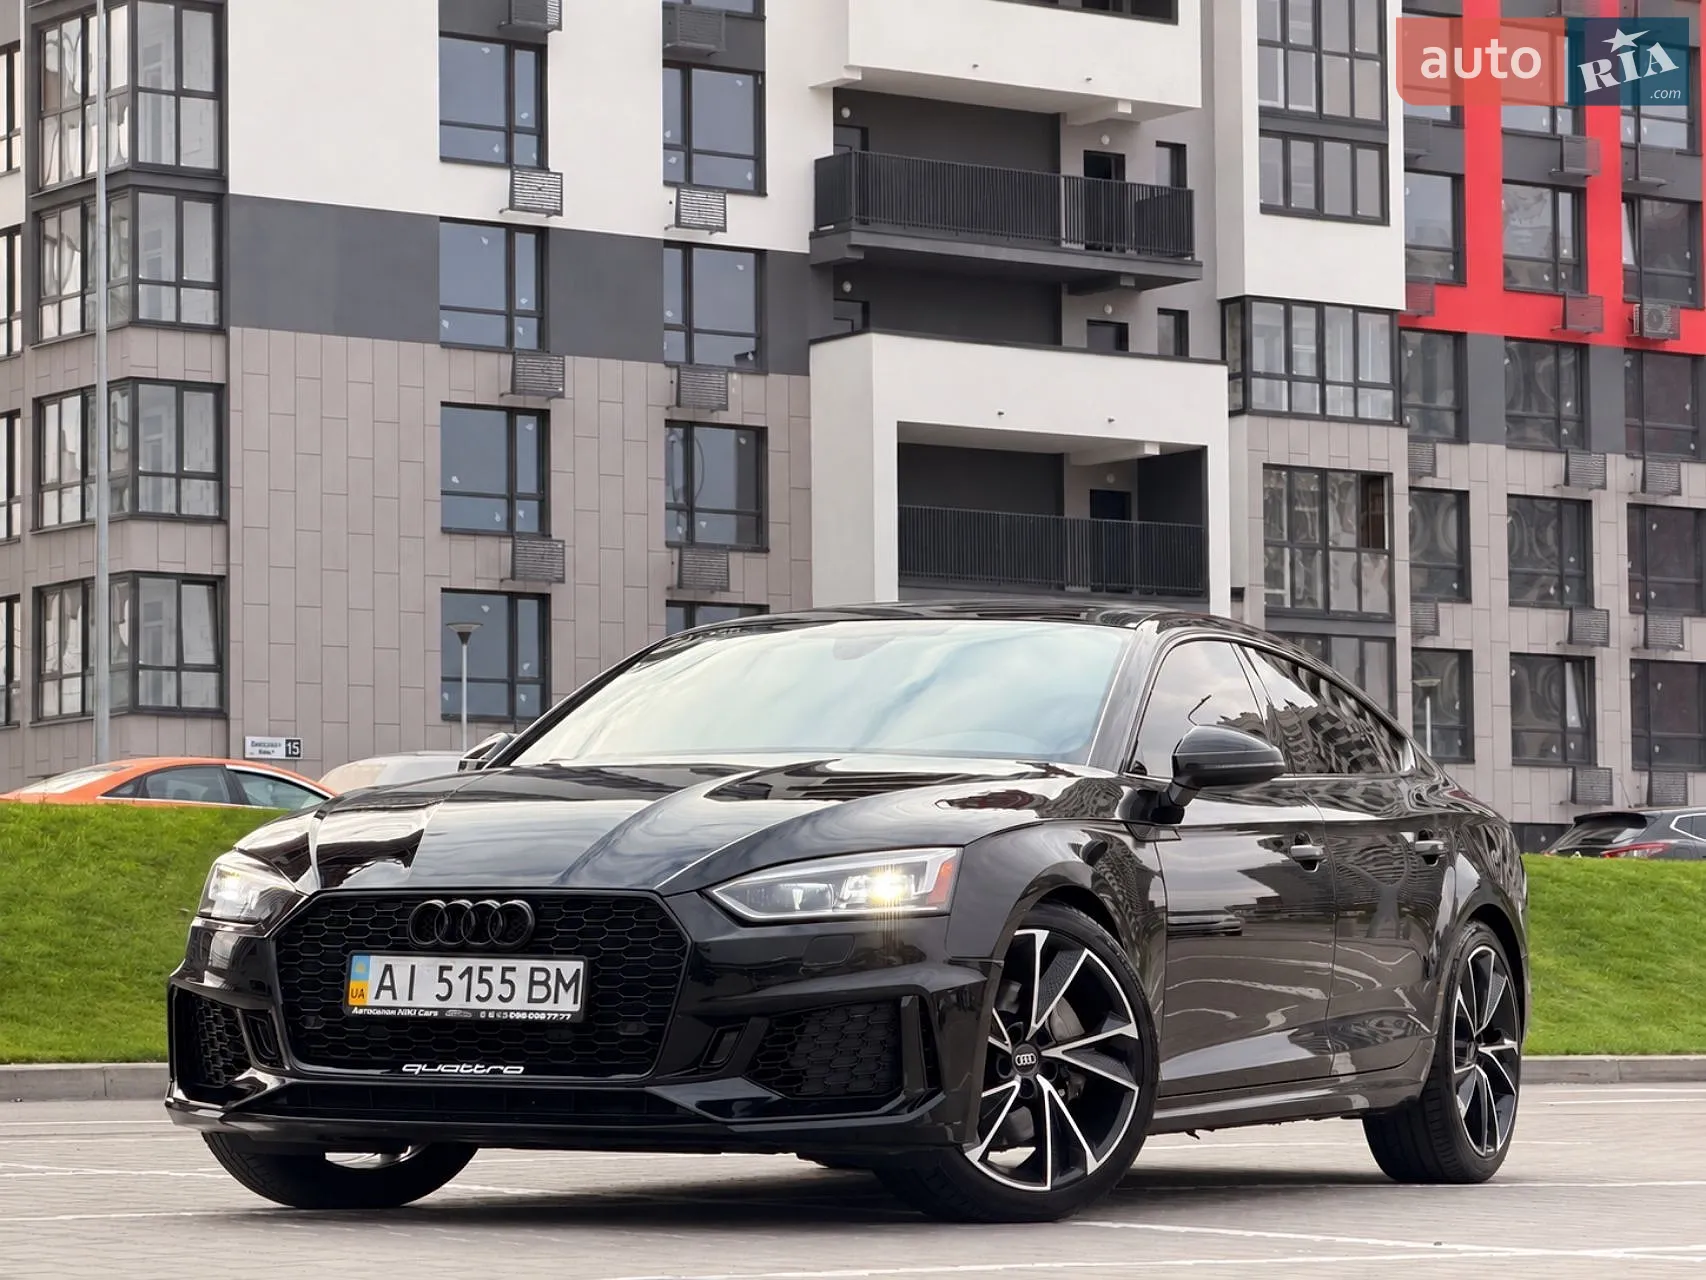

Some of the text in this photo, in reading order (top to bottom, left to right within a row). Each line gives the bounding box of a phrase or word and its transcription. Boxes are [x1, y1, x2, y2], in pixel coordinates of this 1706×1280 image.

[287, 741, 300, 755] 15
[435, 965, 517, 1003] 5155
[350, 988, 365, 1000] UA
[397, 1008, 417, 1016] NIKI
[417, 1009, 438, 1017] Cars
[402, 1063, 525, 1075] quattro
